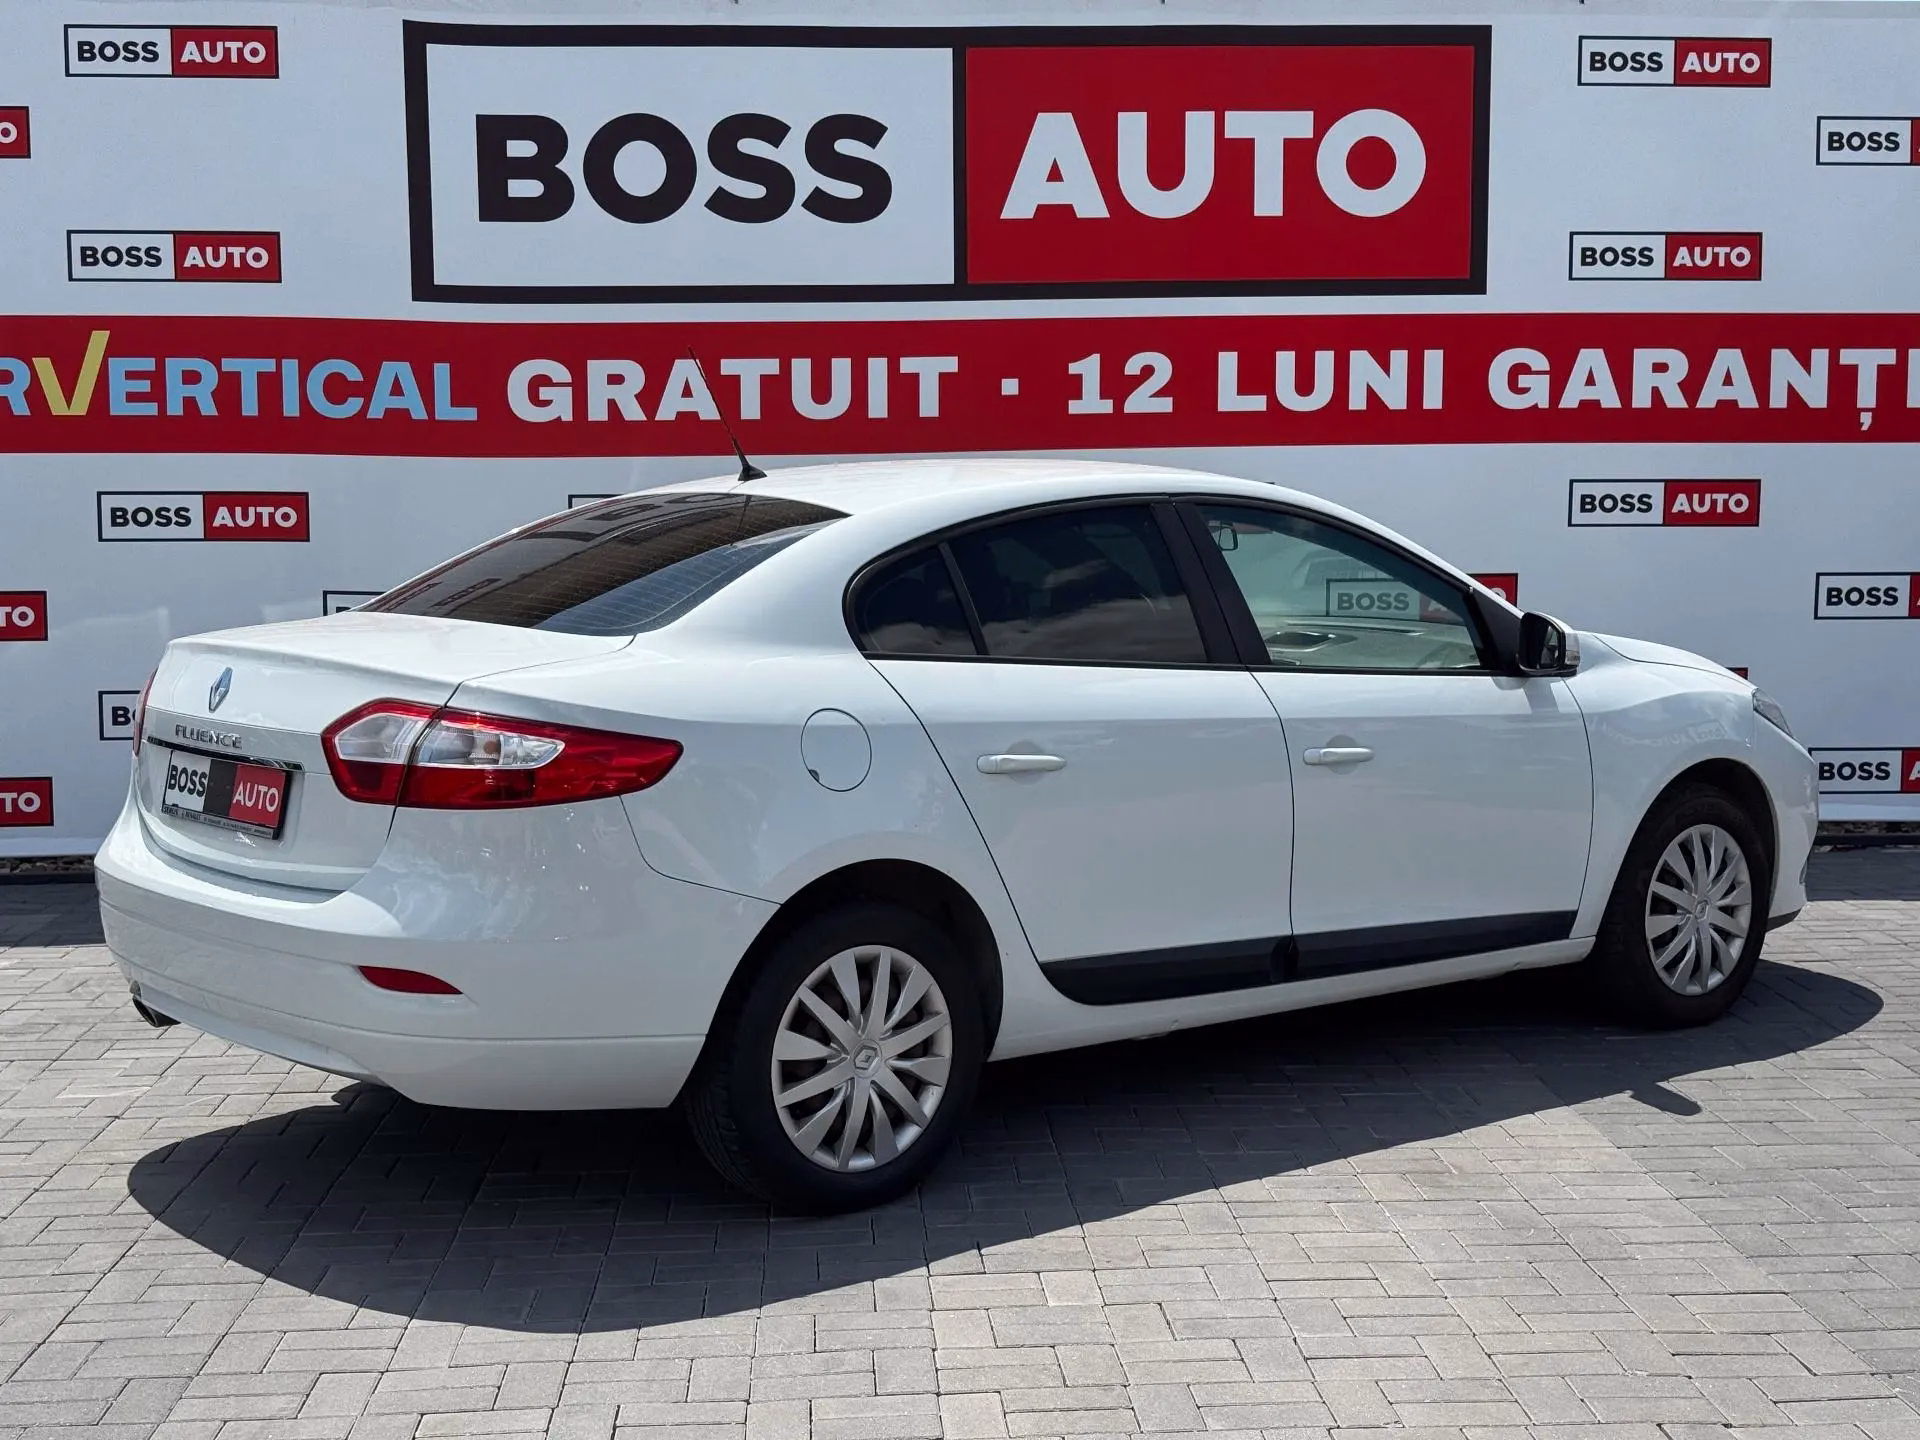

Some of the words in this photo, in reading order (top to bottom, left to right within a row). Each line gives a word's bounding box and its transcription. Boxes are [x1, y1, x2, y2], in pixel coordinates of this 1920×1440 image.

[78, 41, 160, 63] BOSS
[180, 42, 267, 64] AUTO
[1589, 51, 1664, 73] BOSS
[1681, 52, 1761, 73] AUTO
[1827, 131, 1900, 152] BOSS
[476, 113, 893, 225] BOSS
[1000, 109, 1427, 220] AUTO
[80, 246, 163, 268] BOSS
[183, 246, 269, 269] AUTO
[1580, 246, 1655, 267] BOSS
[1672, 247, 1752, 267] AUTO
[507, 356, 958, 423] GRATUIT
[1069, 352, 1174, 414] 12
[1218, 350, 1444, 412] LUNI
[1579, 493, 1653, 514] BOSS
[1671, 493, 1750, 514] AUTO
[110, 506, 192, 528] BOSS
[212, 506, 298, 528] AUTO
[1337, 591, 1410, 611] BOSS
[1826, 586, 1899, 607] BOSS
[174, 724, 243, 749] FLUENCE
[1818, 761, 1891, 781] BOSS
[168, 764, 208, 798] BOSS
[233, 782, 279, 812] AUTO
